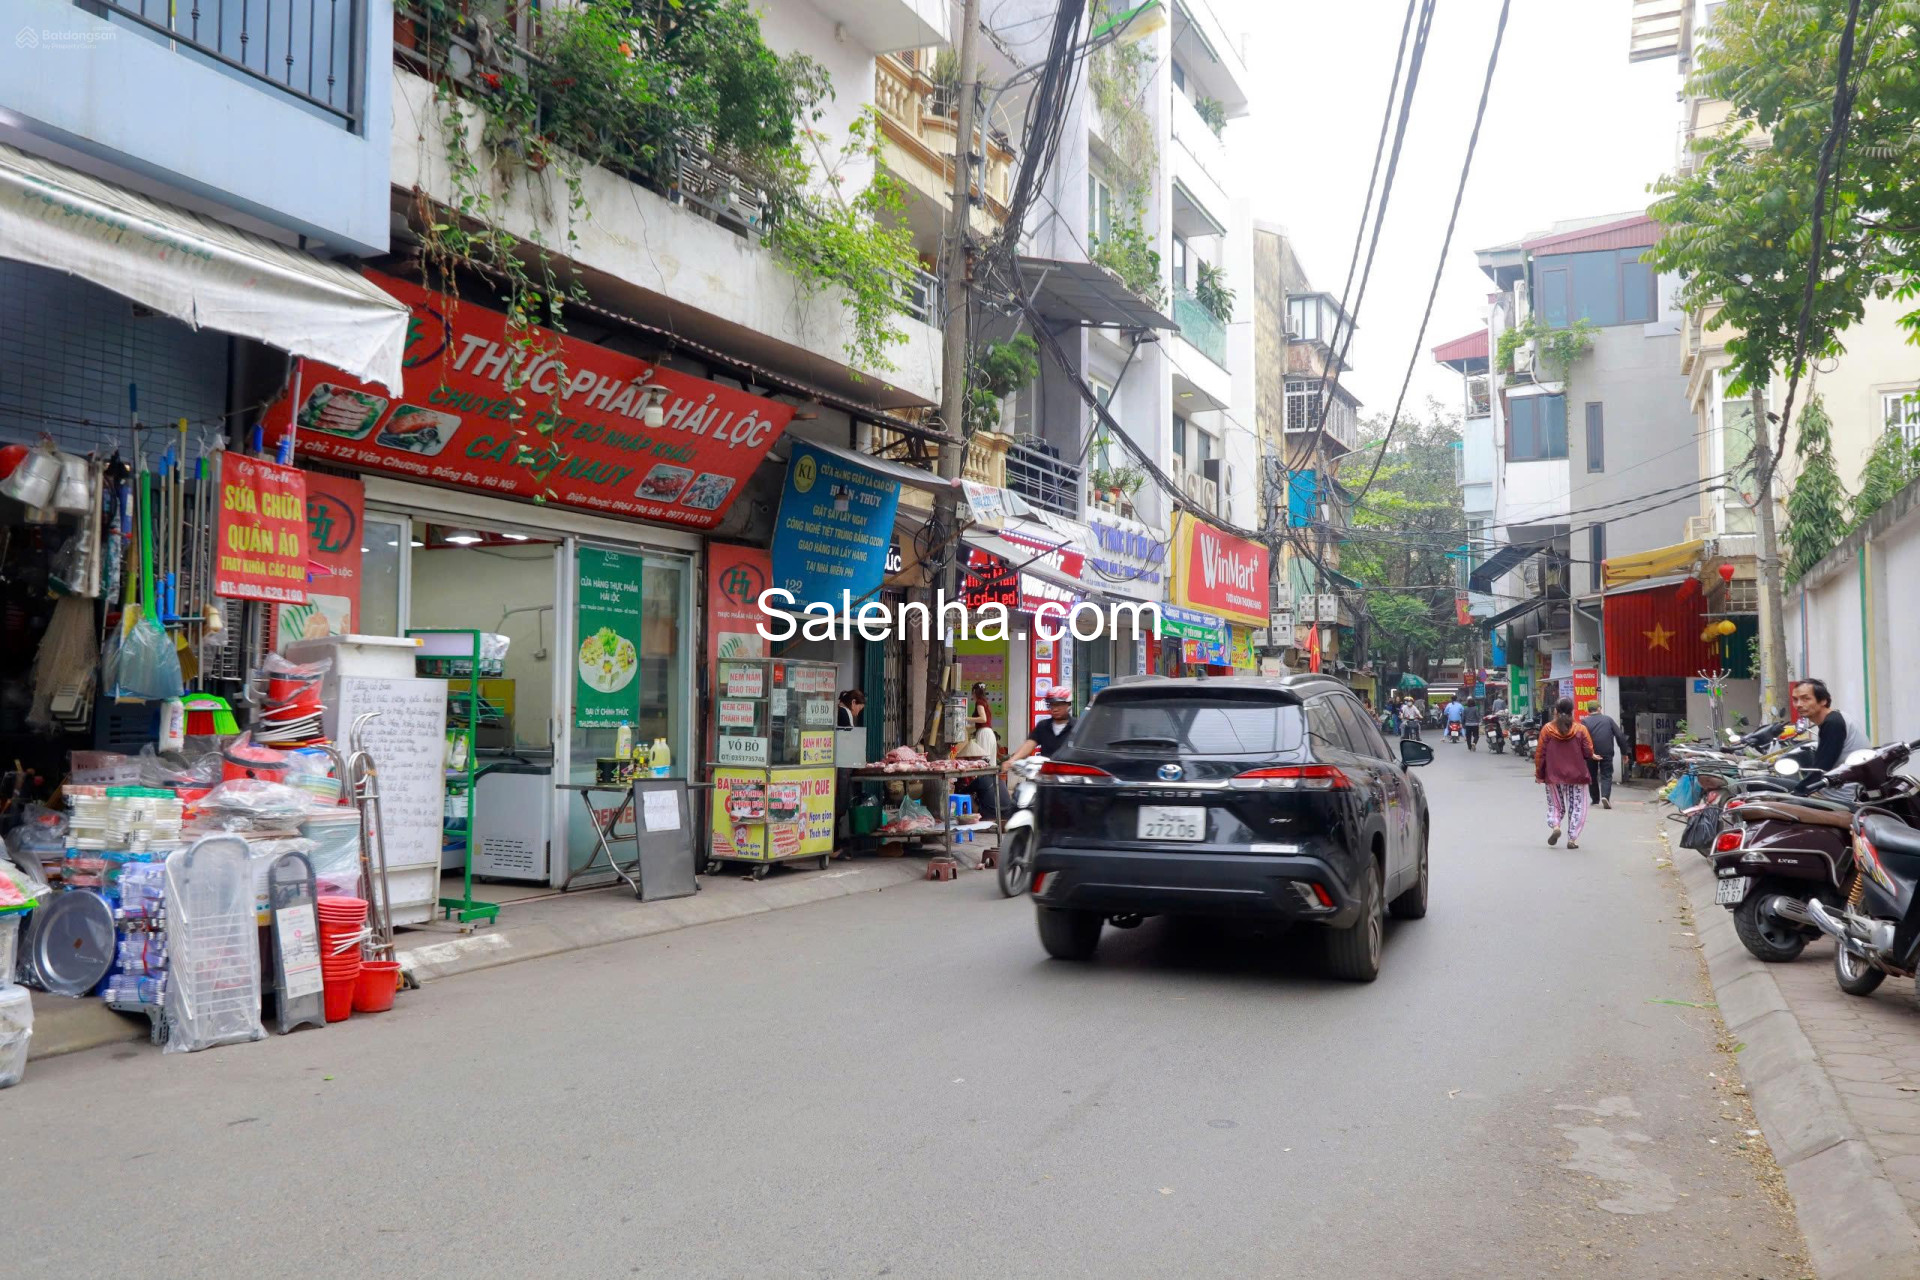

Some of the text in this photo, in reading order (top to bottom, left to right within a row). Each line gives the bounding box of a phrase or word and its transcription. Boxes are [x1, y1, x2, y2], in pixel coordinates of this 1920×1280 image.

[663, 393, 720, 436] HẢI
[712, 409, 772, 449] LỘC
[332, 445, 356, 460] 122
[357, 449, 381, 464] Văn
[382, 455, 429, 475] Chương,
[431, 465, 462, 484] Đống
[482, 474, 498, 487] Hà
[498, 477, 517, 491] Nội
[560, 456, 634, 487] NAUY
[798, 463, 813, 482] KL
[225, 479, 303, 522] SỬA CHỮA
[786, 516, 804, 531] CÔNG
[228, 519, 299, 558] QUẦN ÁO
[798, 539, 814, 551] GIAO
[221, 555, 241, 572] THAY
[268, 560, 286, 578] CÁC
[287, 564, 305, 582] LOẠI
[728, 568, 755, 603] HL
[785, 578, 803, 594] 122
[1575, 684, 1596, 696] VÀNG
[814, 779, 830, 796] QUE
[1146, 823, 1196, 838] 272.06
